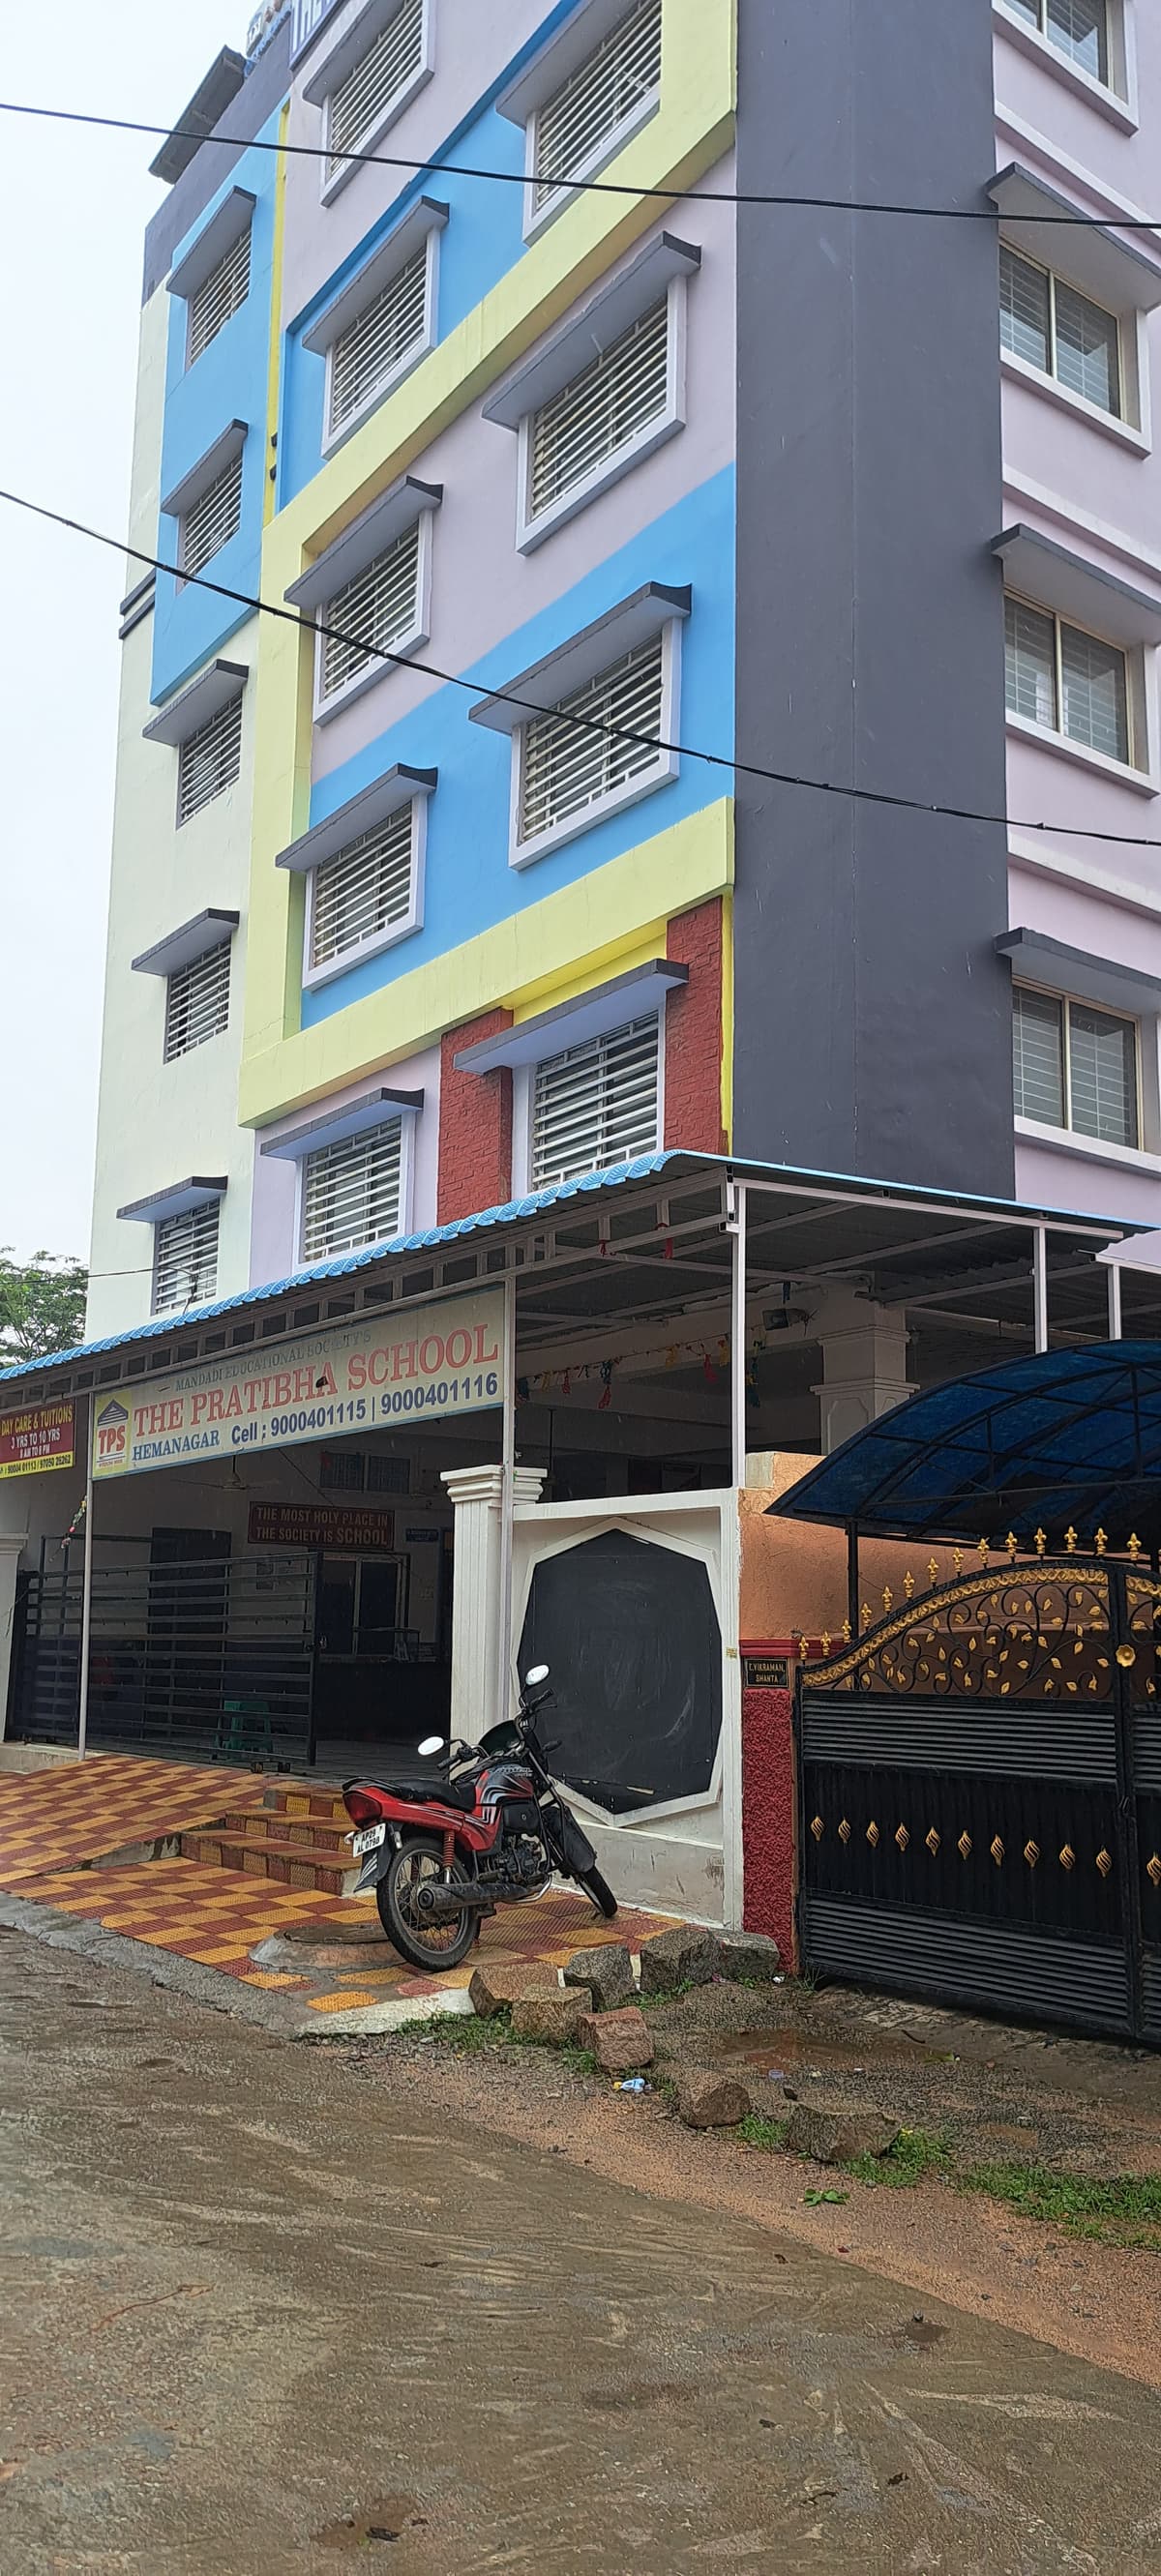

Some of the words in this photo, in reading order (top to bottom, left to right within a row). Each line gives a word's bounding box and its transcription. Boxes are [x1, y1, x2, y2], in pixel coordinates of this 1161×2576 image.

[176, 1367, 223, 1392] MANDADI
[224, 1346, 305, 1377] EDUCATIONAL
[307, 1330, 372, 1358] SOCTY'S
[134, 1398, 184, 1437] THE
[190, 1361, 339, 1426] PRATIBHA
[347, 1323, 498, 1391] SCHOOL
[1, 1418, 14, 1436] DAY
[15, 1413, 32, 1434] CARE
[41, 1405, 73, 1428] TUITIONS
[231, 1421, 257, 1444] Cell
[271, 1399, 366, 1437] 9000401115
[381, 1372, 498, 1415] 9000401116
[16, 1434, 28, 1449] YRS
[29, 1433, 38, 1445] TO
[39, 1431, 46, 1443] 10
[47, 1428, 61, 1442] YRS
[98, 1425, 126, 1456] TPS
[132, 1430, 221, 1462] HEMANAGAR
[255, 1506, 278, 1521] THE
[280, 1508, 311, 1523] MOST
[313, 1510, 339, 1525] HOLY
[342, 1512, 374, 1526] PLACE
[377, 1513, 388, 1526] IN
[255, 1526, 277, 1540] THE
[279, 1527, 321, 1542] SOCIETY
[323, 1530, 333, 1543] IS
[337, 1527, 388, 1546] SCHOOL
